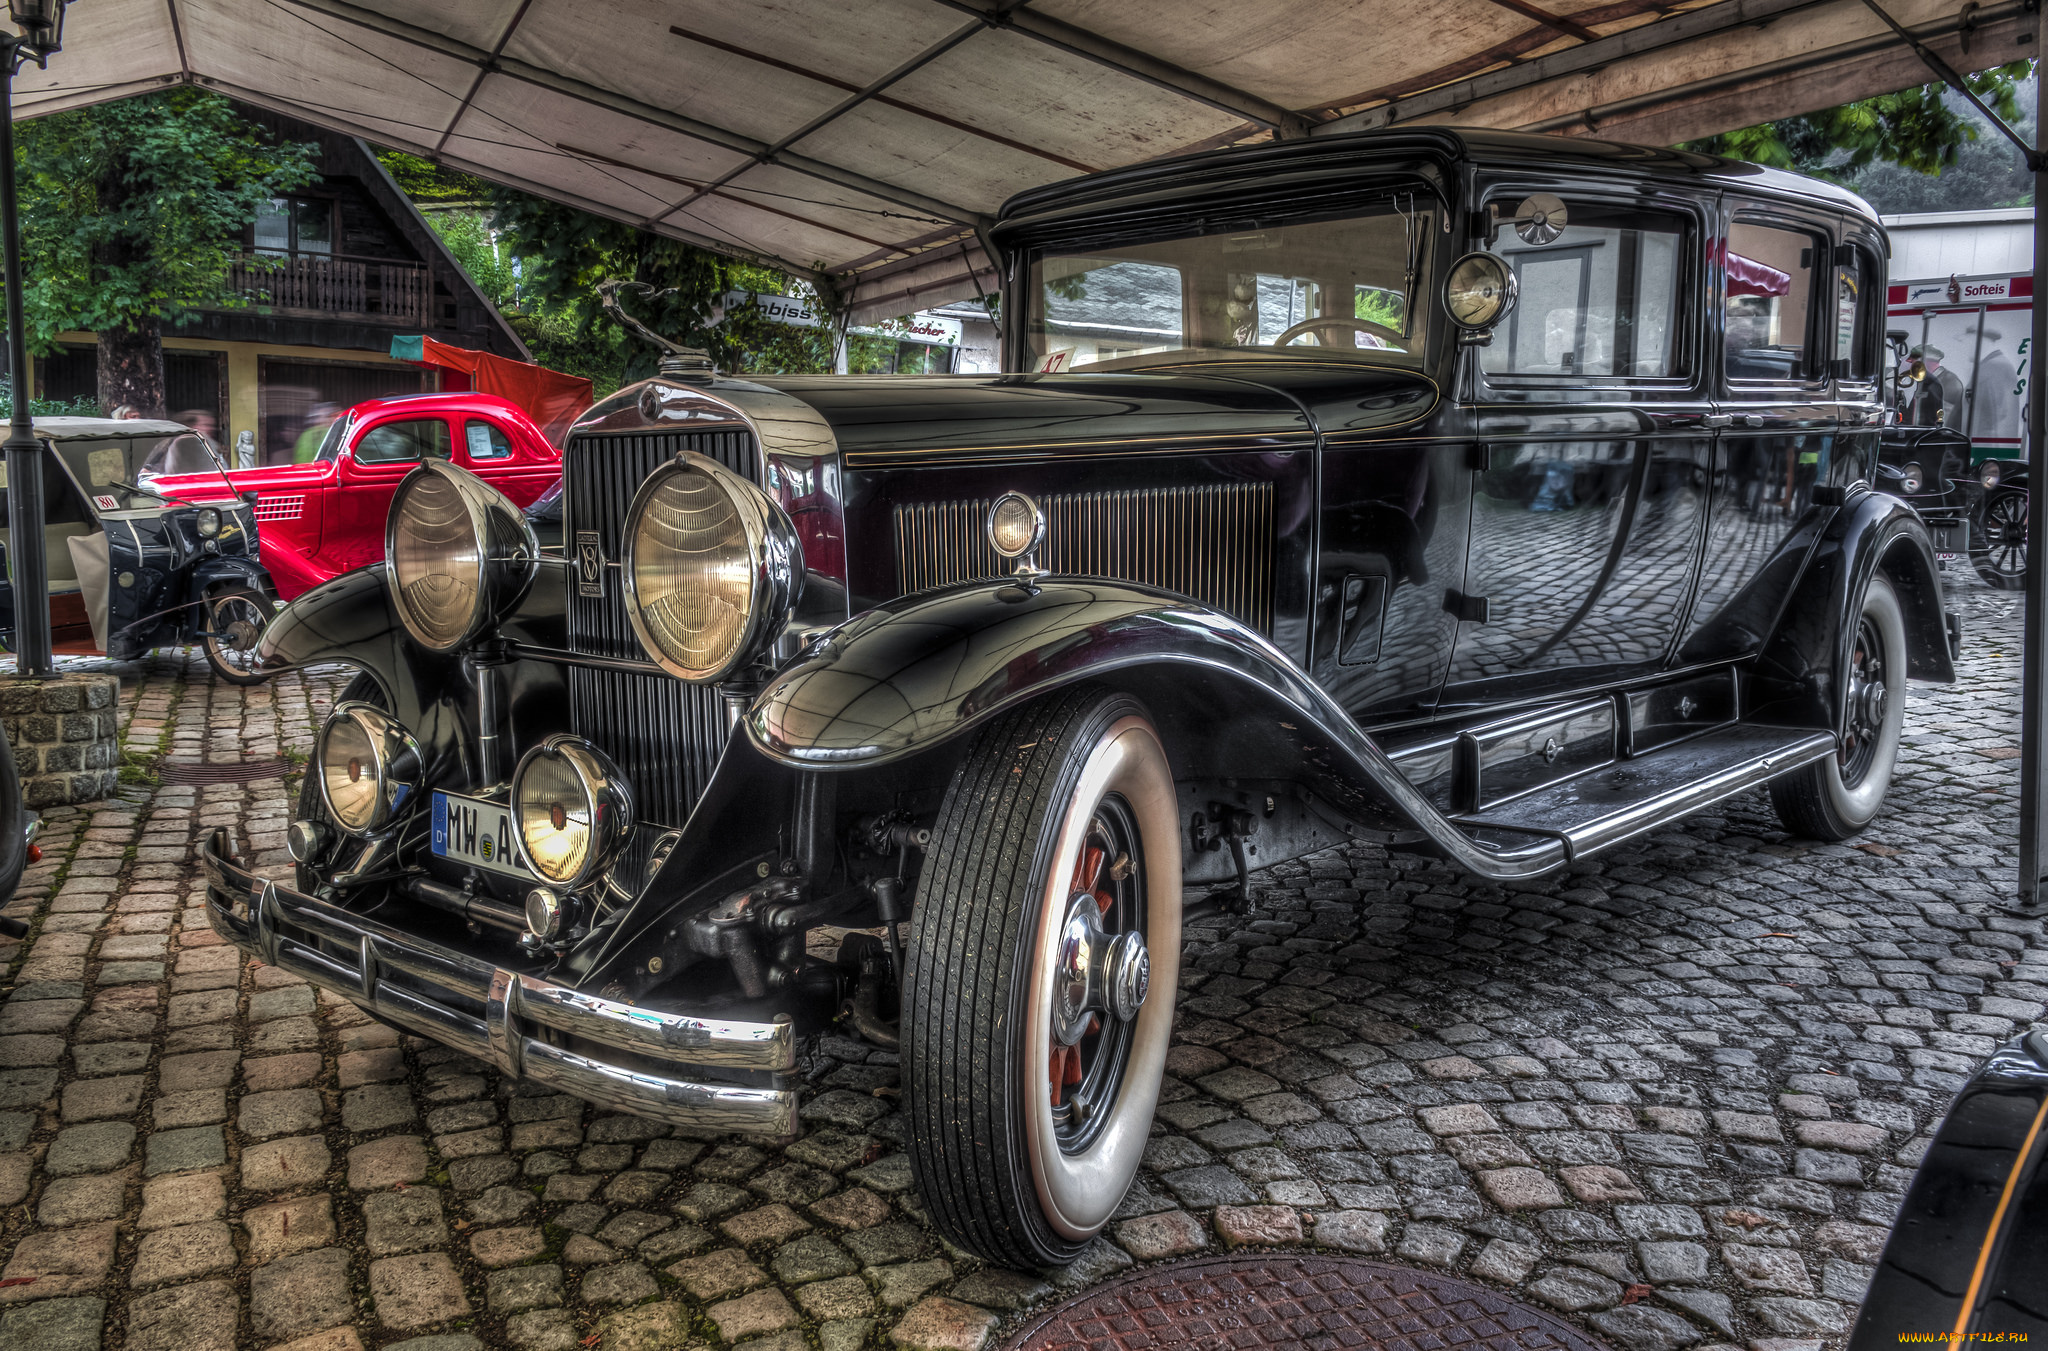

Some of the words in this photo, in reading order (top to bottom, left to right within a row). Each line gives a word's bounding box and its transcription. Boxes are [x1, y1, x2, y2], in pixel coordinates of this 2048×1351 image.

[1964, 283, 2005, 297] Softeis
[1040, 352, 1066, 374] 47
[2013, 337, 2031, 396] EIS
[97, 495, 115, 509] 80
[436, 829, 443, 843] D
[447, 802, 478, 856] MW
